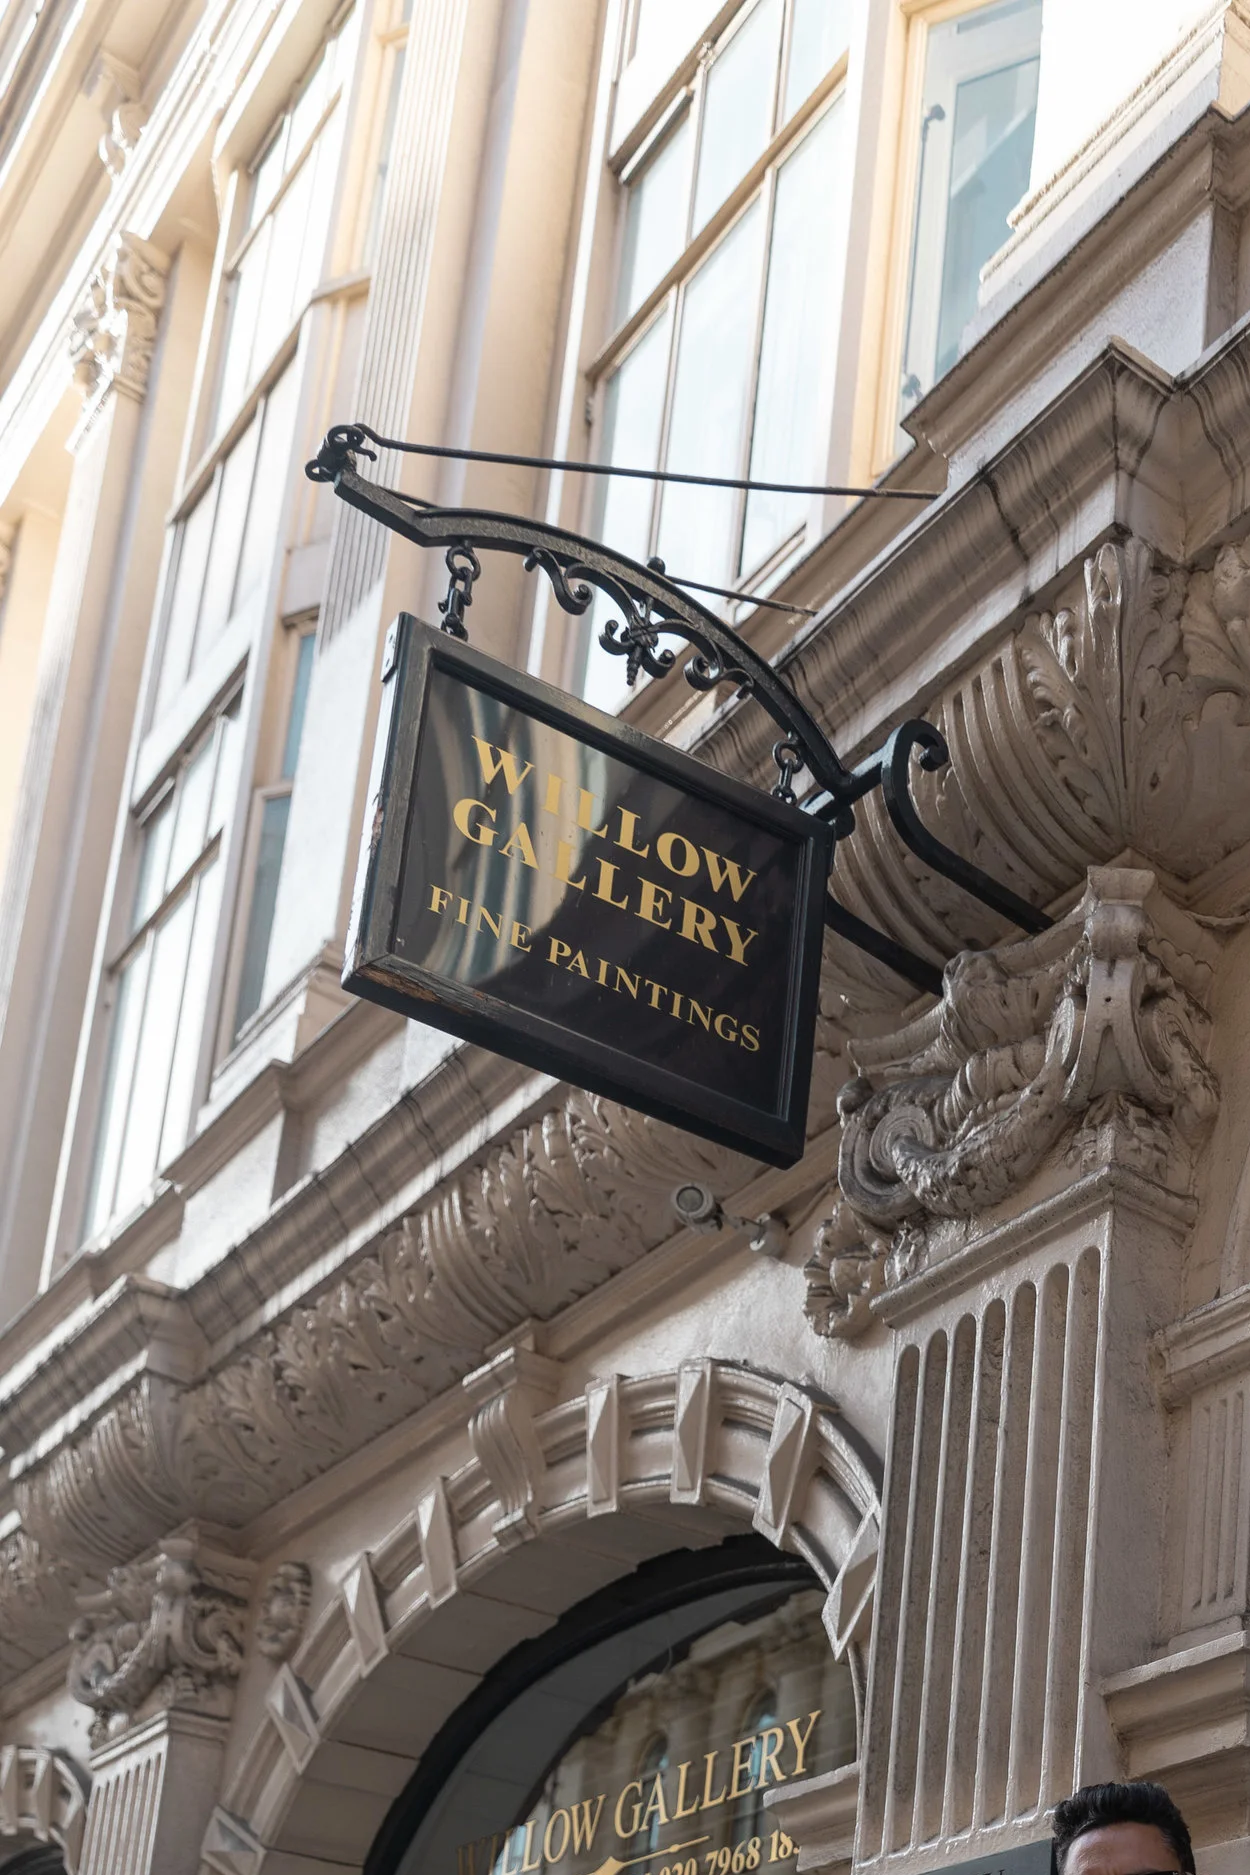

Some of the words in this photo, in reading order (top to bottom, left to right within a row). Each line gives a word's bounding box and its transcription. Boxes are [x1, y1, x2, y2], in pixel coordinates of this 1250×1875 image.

[453, 797, 759, 967] GALLERY
[471, 735, 758, 904] WILLOW
[429, 884, 533, 953] FINE
[546, 936, 762, 1053] PAINTINGS
[614, 1710, 822, 1839] GALLERY
[768, 1829, 801, 1863] 18
